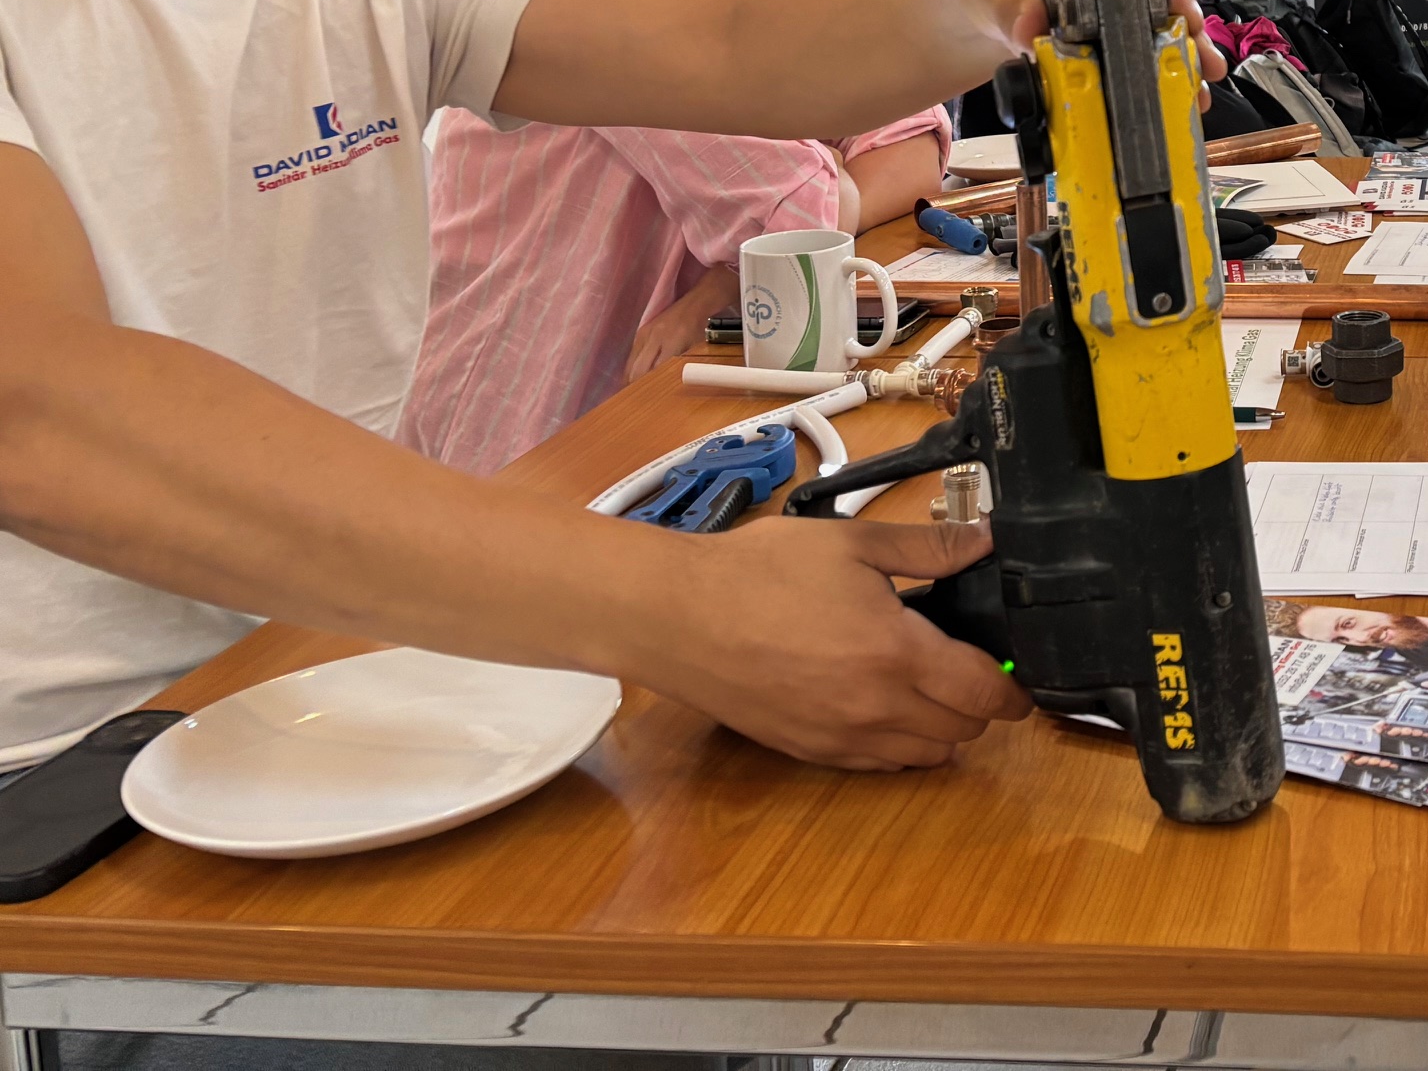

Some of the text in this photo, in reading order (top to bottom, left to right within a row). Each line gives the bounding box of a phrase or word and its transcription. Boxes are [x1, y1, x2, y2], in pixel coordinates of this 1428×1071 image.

[252, 145, 332, 179] DAVID
[257, 170, 308, 193] Sanitär
[374, 134, 400, 147] Gas
[1242, 329, 1259, 340] Gas
[1152, 633, 1196, 750] REMS
